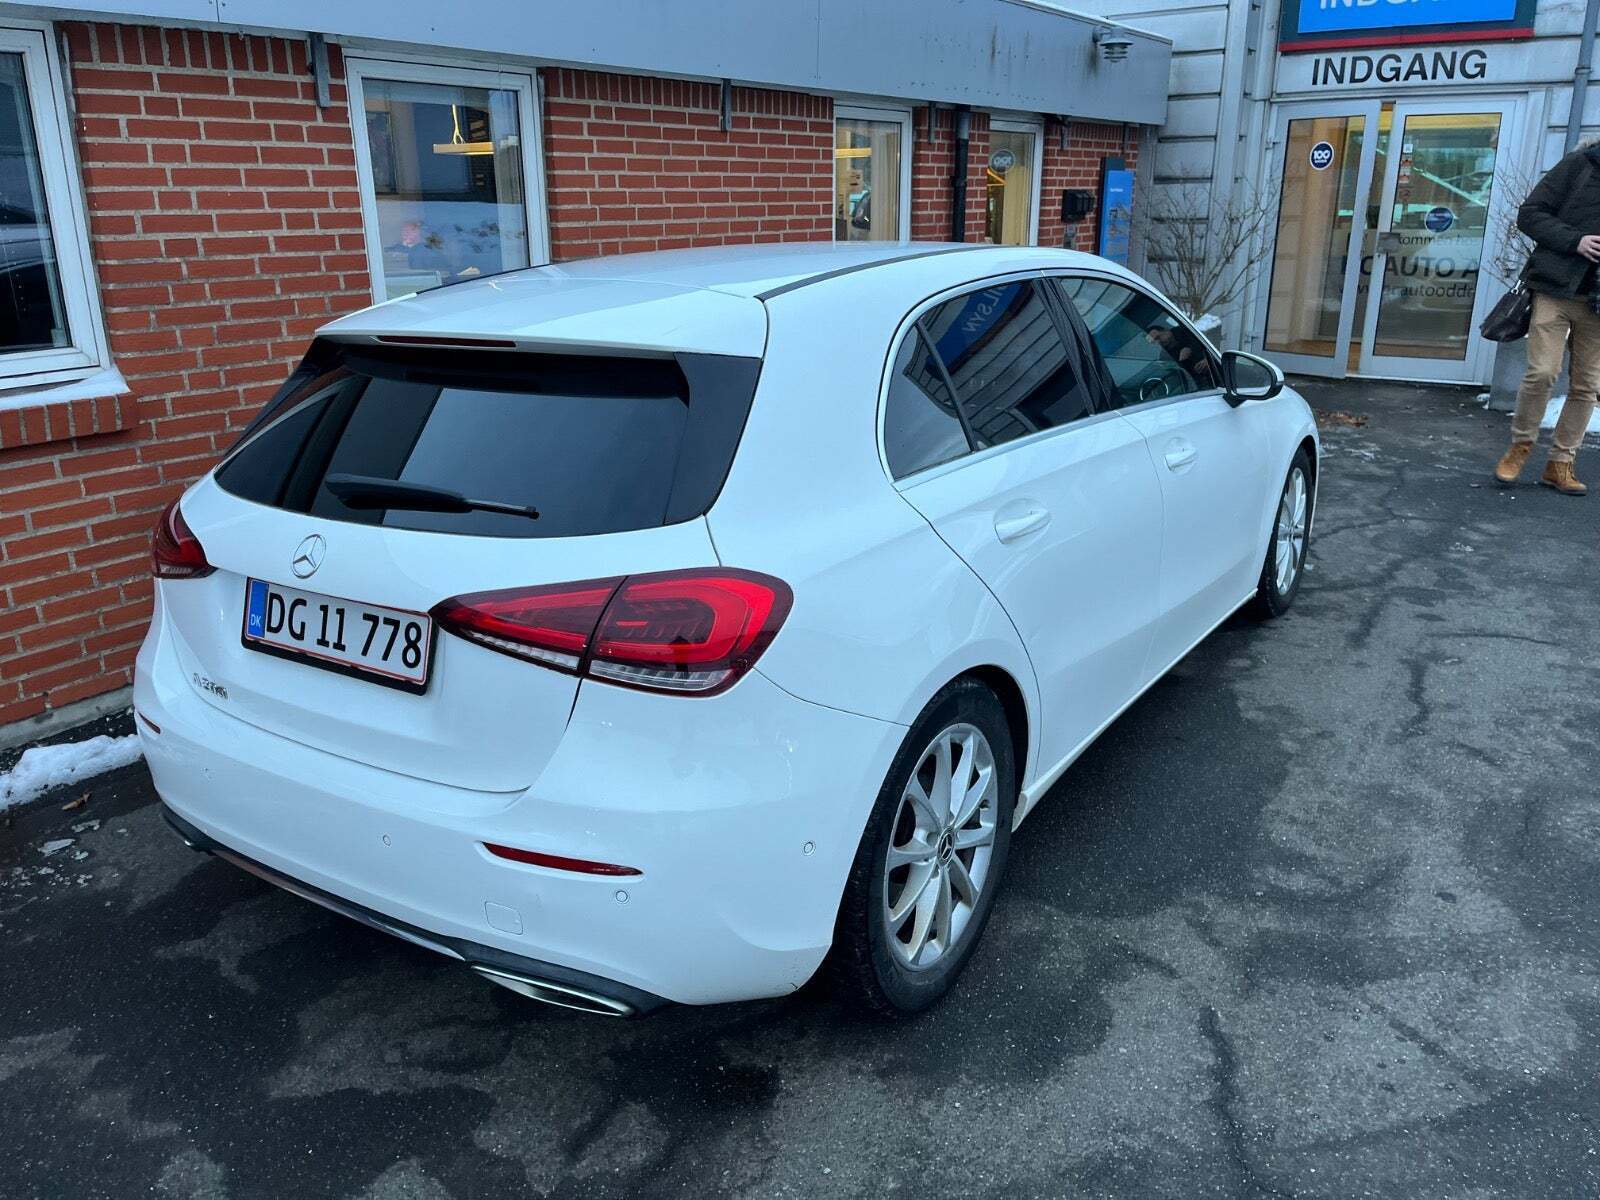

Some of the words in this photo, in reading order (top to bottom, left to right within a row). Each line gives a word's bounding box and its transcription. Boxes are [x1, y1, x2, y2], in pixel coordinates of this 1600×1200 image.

[1311, 49, 1487, 86] INDGANG
[249, 614, 263, 628] DK
[266, 592, 308, 641] DG
[316, 604, 347, 652] 11
[361, 612, 423, 669] 778
